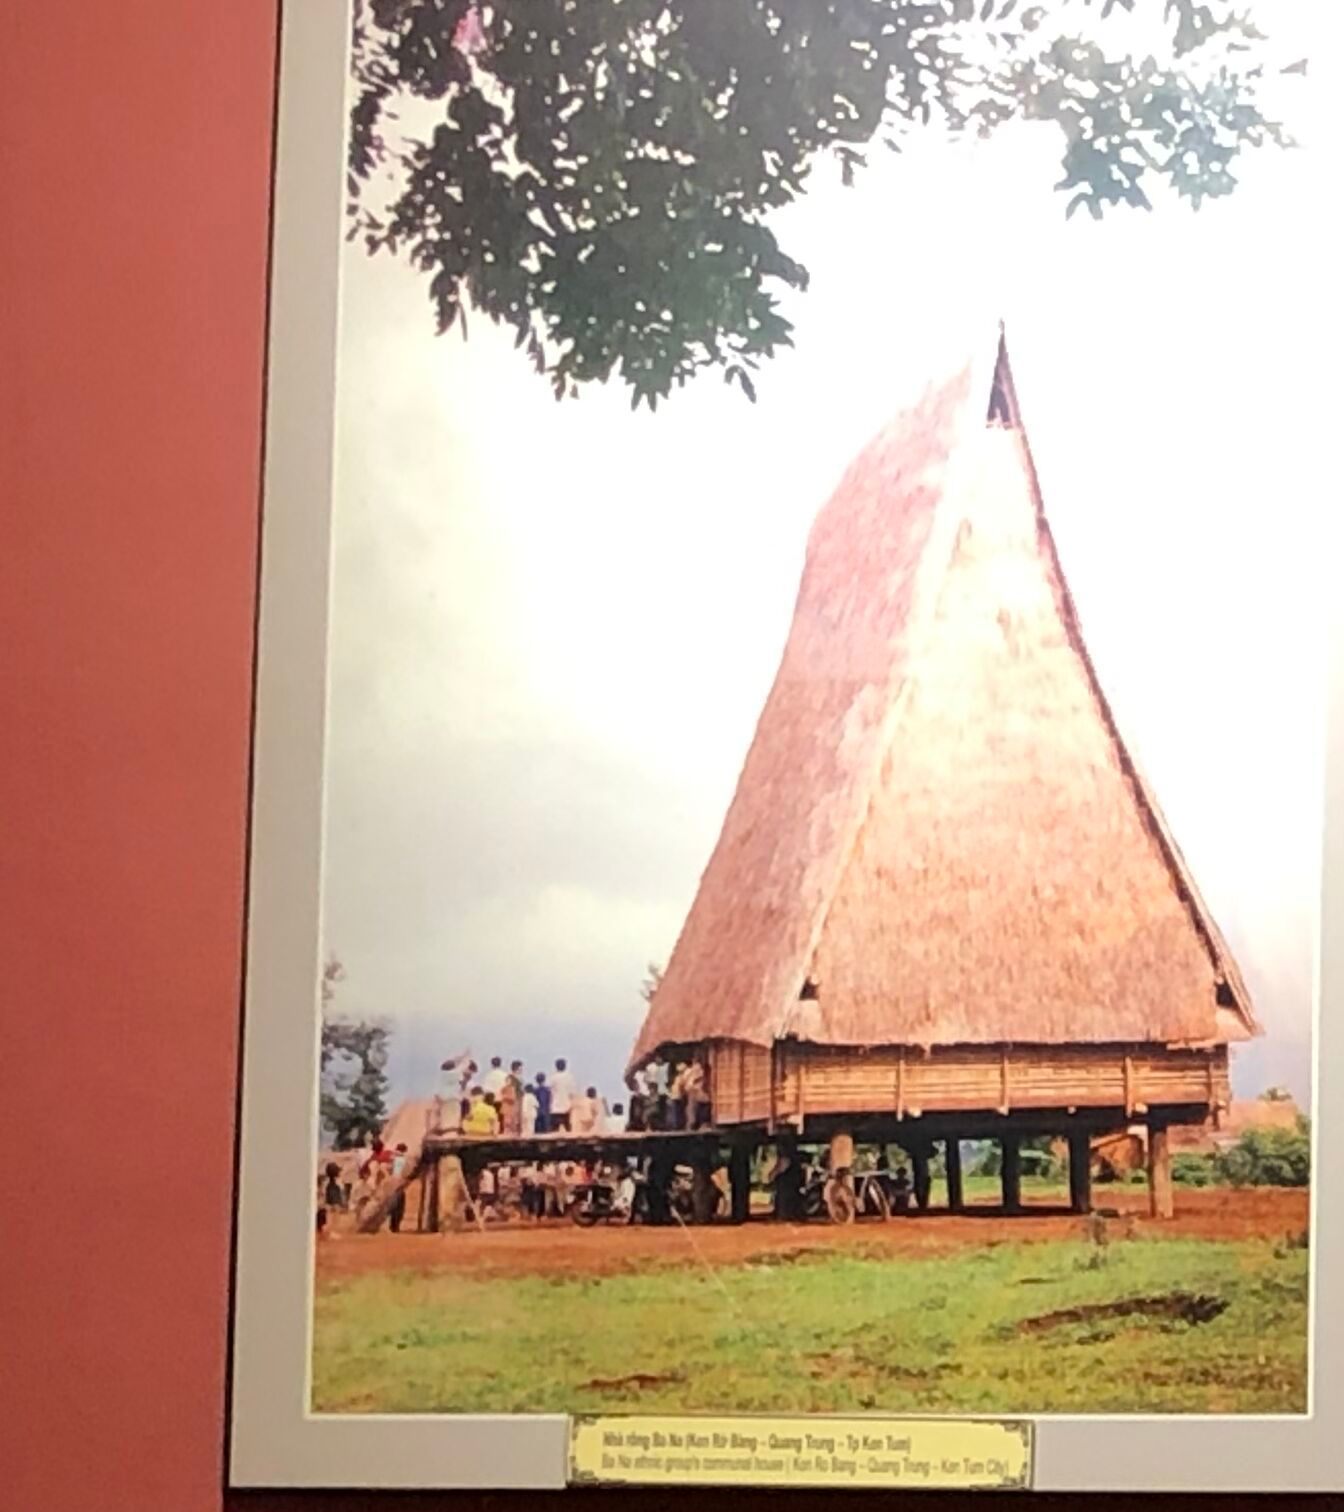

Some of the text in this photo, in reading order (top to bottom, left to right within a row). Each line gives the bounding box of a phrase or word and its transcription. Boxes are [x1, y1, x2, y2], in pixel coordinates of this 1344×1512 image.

[603, 1431, 623, 1446] Nhà
[669, 1433, 684, 1447] Na
[769, 1433, 802, 1453] Quang
[806, 1434, 834, 1453] Trung
[863, 1436, 883, 1450] Kon
[635, 1455, 662, 1470] ethnic
[703, 1457, 752, 1471] communal
[755, 1458, 783, 1471] house
[793, 1458, 812, 1471] Kon
[868, 1458, 900, 1477] Quang
[903, 1457, 930, 1477] Trung
[941, 1459, 960, 1473] Kon
[963, 1459, 984, 1474] Tum
